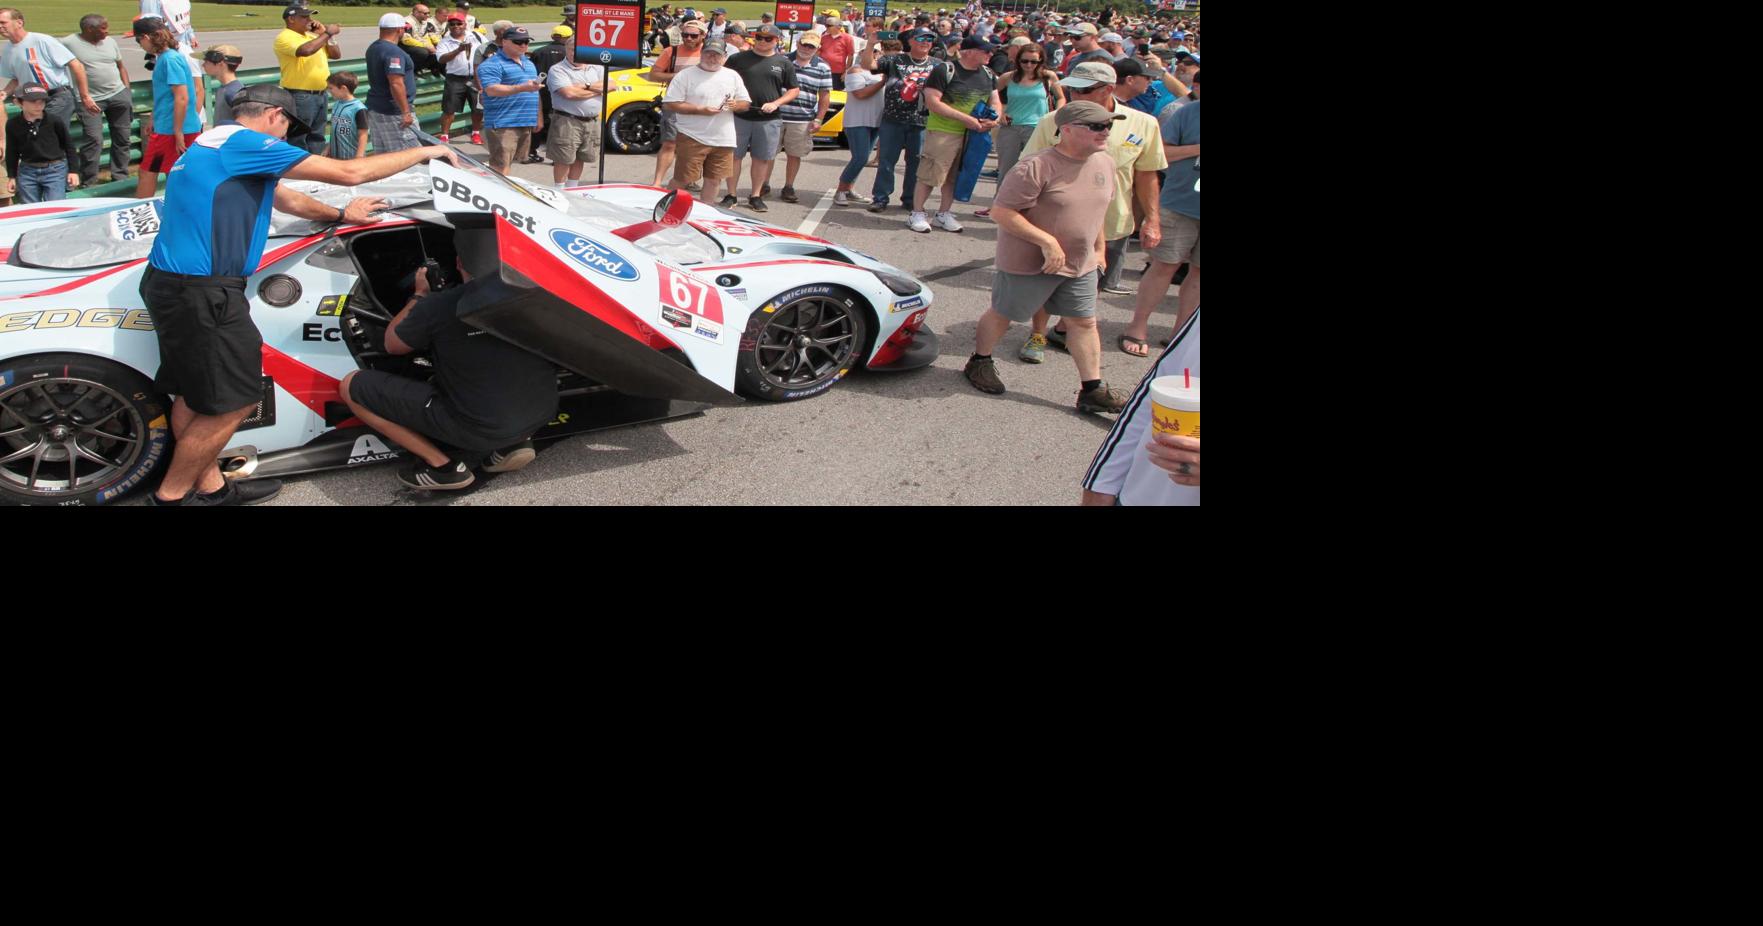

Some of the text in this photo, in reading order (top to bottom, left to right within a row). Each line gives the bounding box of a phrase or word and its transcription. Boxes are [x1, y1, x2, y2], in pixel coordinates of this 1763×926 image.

[788, 10, 799, 22] 3
[589, 18, 625, 46] 67
[432, 176, 537, 234] oBoost
[567, 236, 623, 275] Ford
[669, 271, 709, 315] 67
[782, 287, 830, 303] MICHELIN
[0, 308, 155, 333] EDGE
[103, 442, 163, 500] MICHELIN
[347, 452, 400, 465] AXALTA
